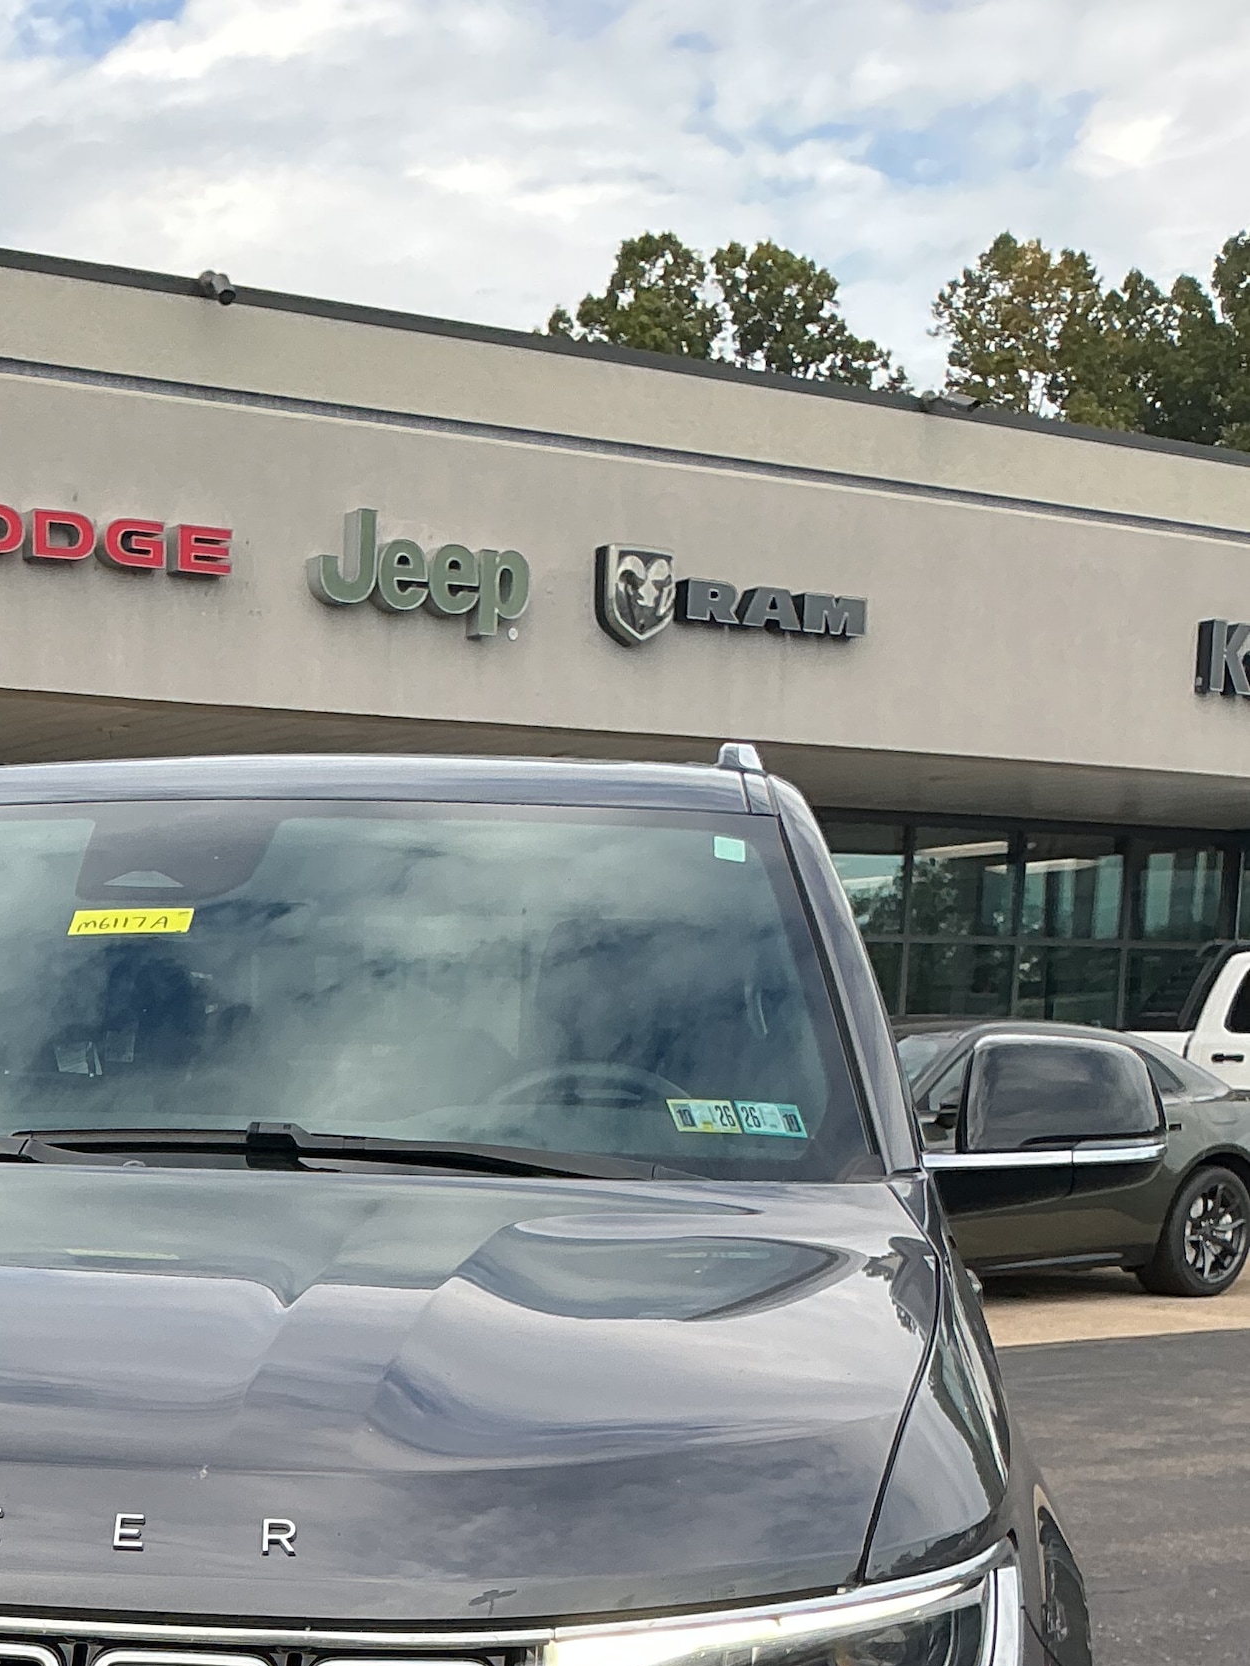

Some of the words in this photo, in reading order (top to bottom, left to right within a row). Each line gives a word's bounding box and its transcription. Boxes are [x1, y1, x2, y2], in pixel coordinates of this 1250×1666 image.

[306, 508, 530, 638] Jeep
[675, 577, 868, 637] RAM
[1195, 617, 1250, 697] K
[715, 1105, 736, 1127] 26
[740, 1106, 761, 1128] 26
